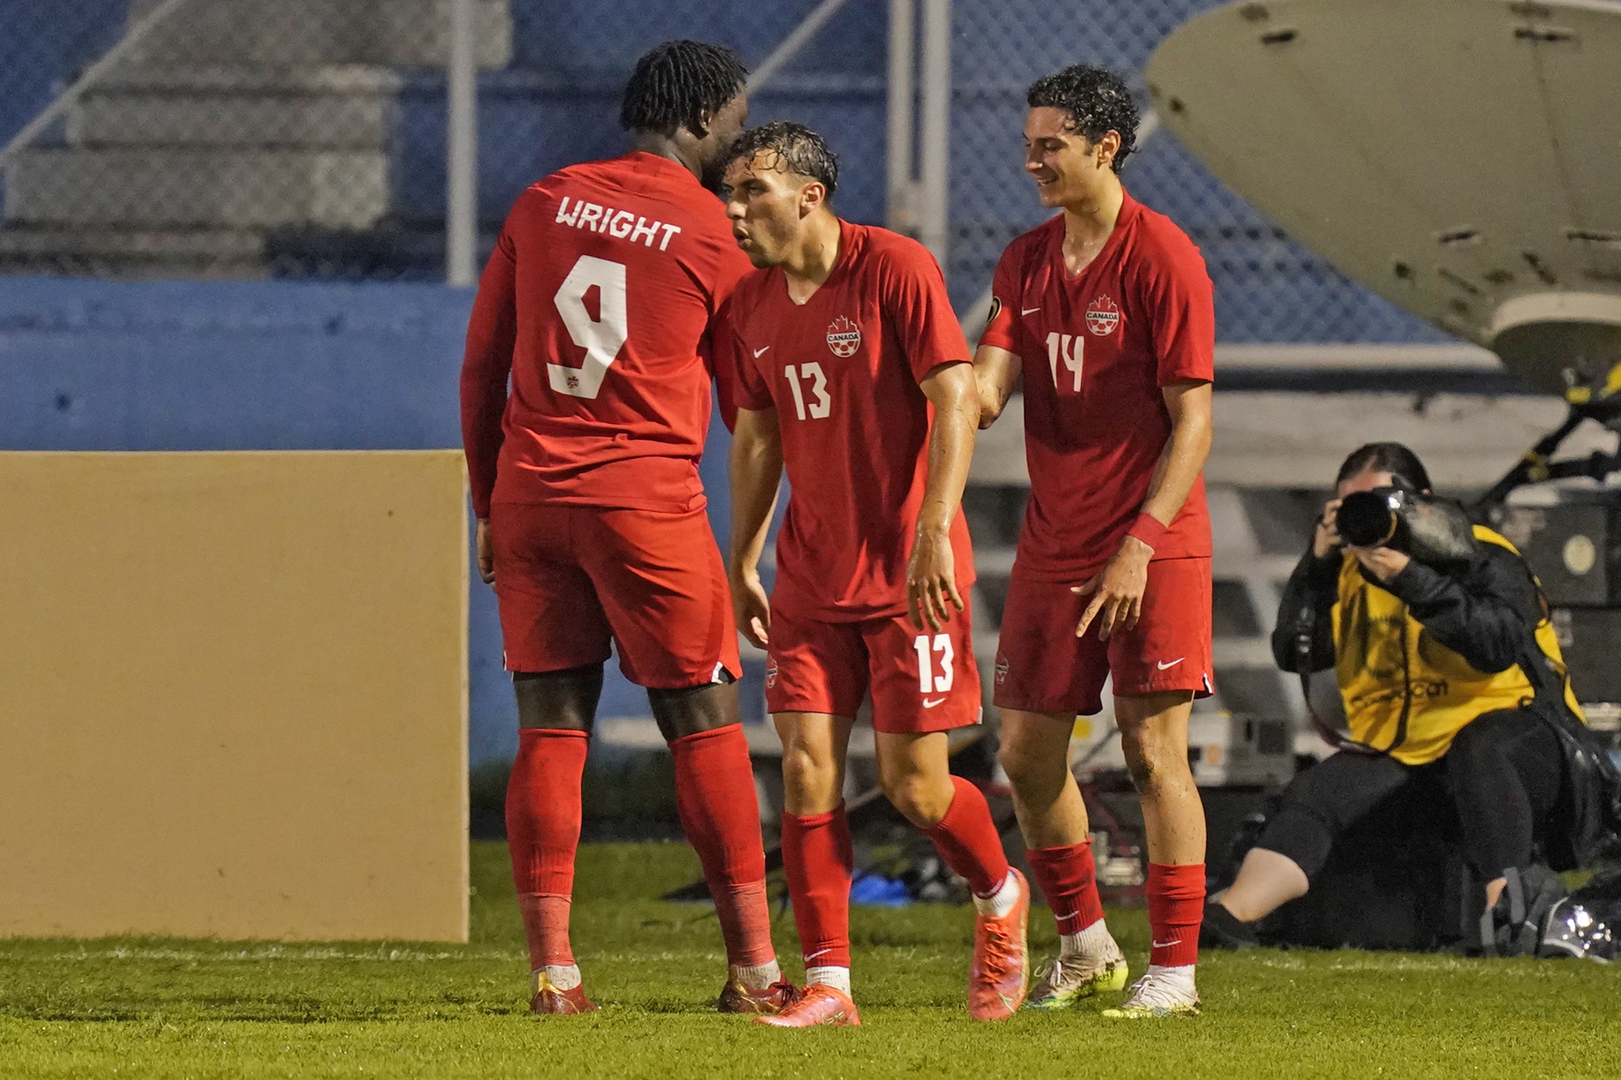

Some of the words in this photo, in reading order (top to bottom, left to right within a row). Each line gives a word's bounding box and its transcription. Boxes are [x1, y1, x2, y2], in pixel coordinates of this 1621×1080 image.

[555, 196, 682, 251] WRIGHT
[546, 254, 628, 399] 9
[827, 333, 859, 342] CANADA
[1086, 312, 1118, 321] CANADA
[784, 361, 831, 420] 13
[1045, 332, 1085, 392] 14
[913, 633, 954, 693] 13
